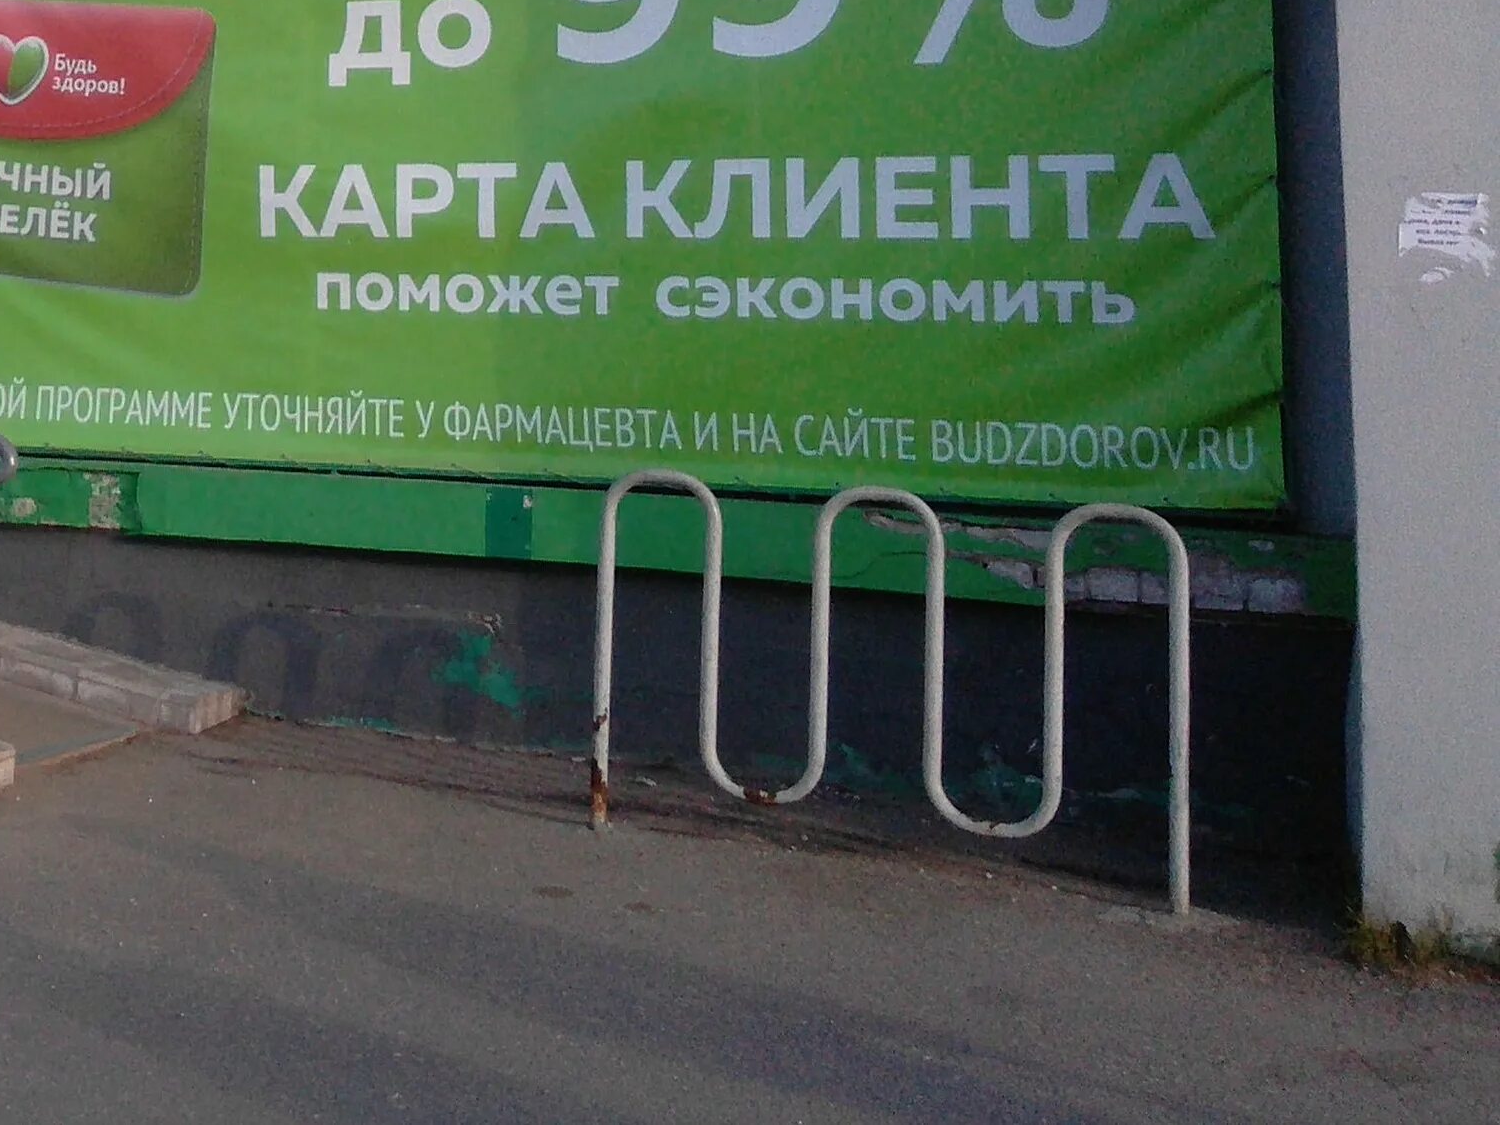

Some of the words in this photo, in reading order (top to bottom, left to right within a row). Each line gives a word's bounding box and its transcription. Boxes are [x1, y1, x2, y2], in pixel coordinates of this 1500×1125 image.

[52, 75, 125, 97] здоров!
[53, 52, 98, 76] Будь
[258, 160, 596, 239] КАРТА
[625, 154, 1216, 241] КЛИЕНТА
[315, 270, 620, 316] поможет
[654, 274, 1137, 325] сэкономить
[35, 384, 213, 429] ПРОГРАММЕ
[223, 389, 405, 438] УТОЧНЯЙТЕ
[415, 400, 435, 440] У
[442, 400, 683, 452] ФАРМАЦЕВТА
[694, 410, 718, 452] И
[732, 412, 784, 455] НА
[794, 407, 917, 462] САЙТЕ
[931, 418, 1254, 472] BUDZDOROV.RU
